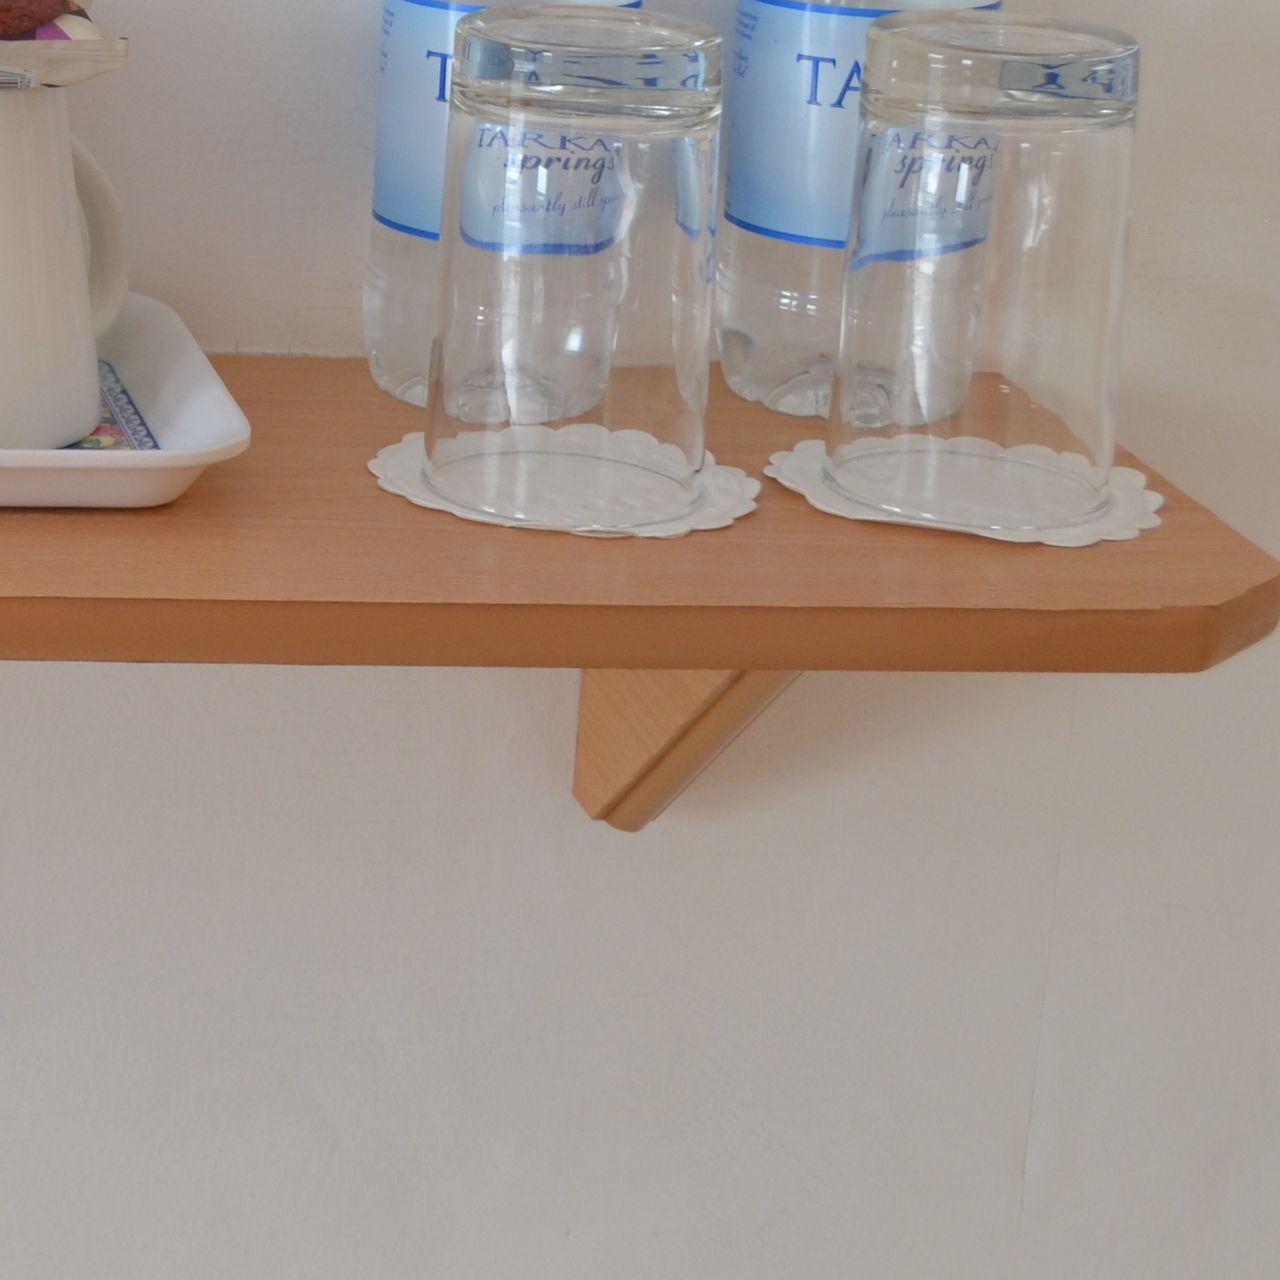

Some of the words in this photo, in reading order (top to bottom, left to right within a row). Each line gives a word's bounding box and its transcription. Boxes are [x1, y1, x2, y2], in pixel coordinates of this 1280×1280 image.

[478, 128, 611, 152] TARKA
[890, 131, 992, 150] ARKA
[504, 150, 616, 185] prings
[894, 149, 994, 188] spings
